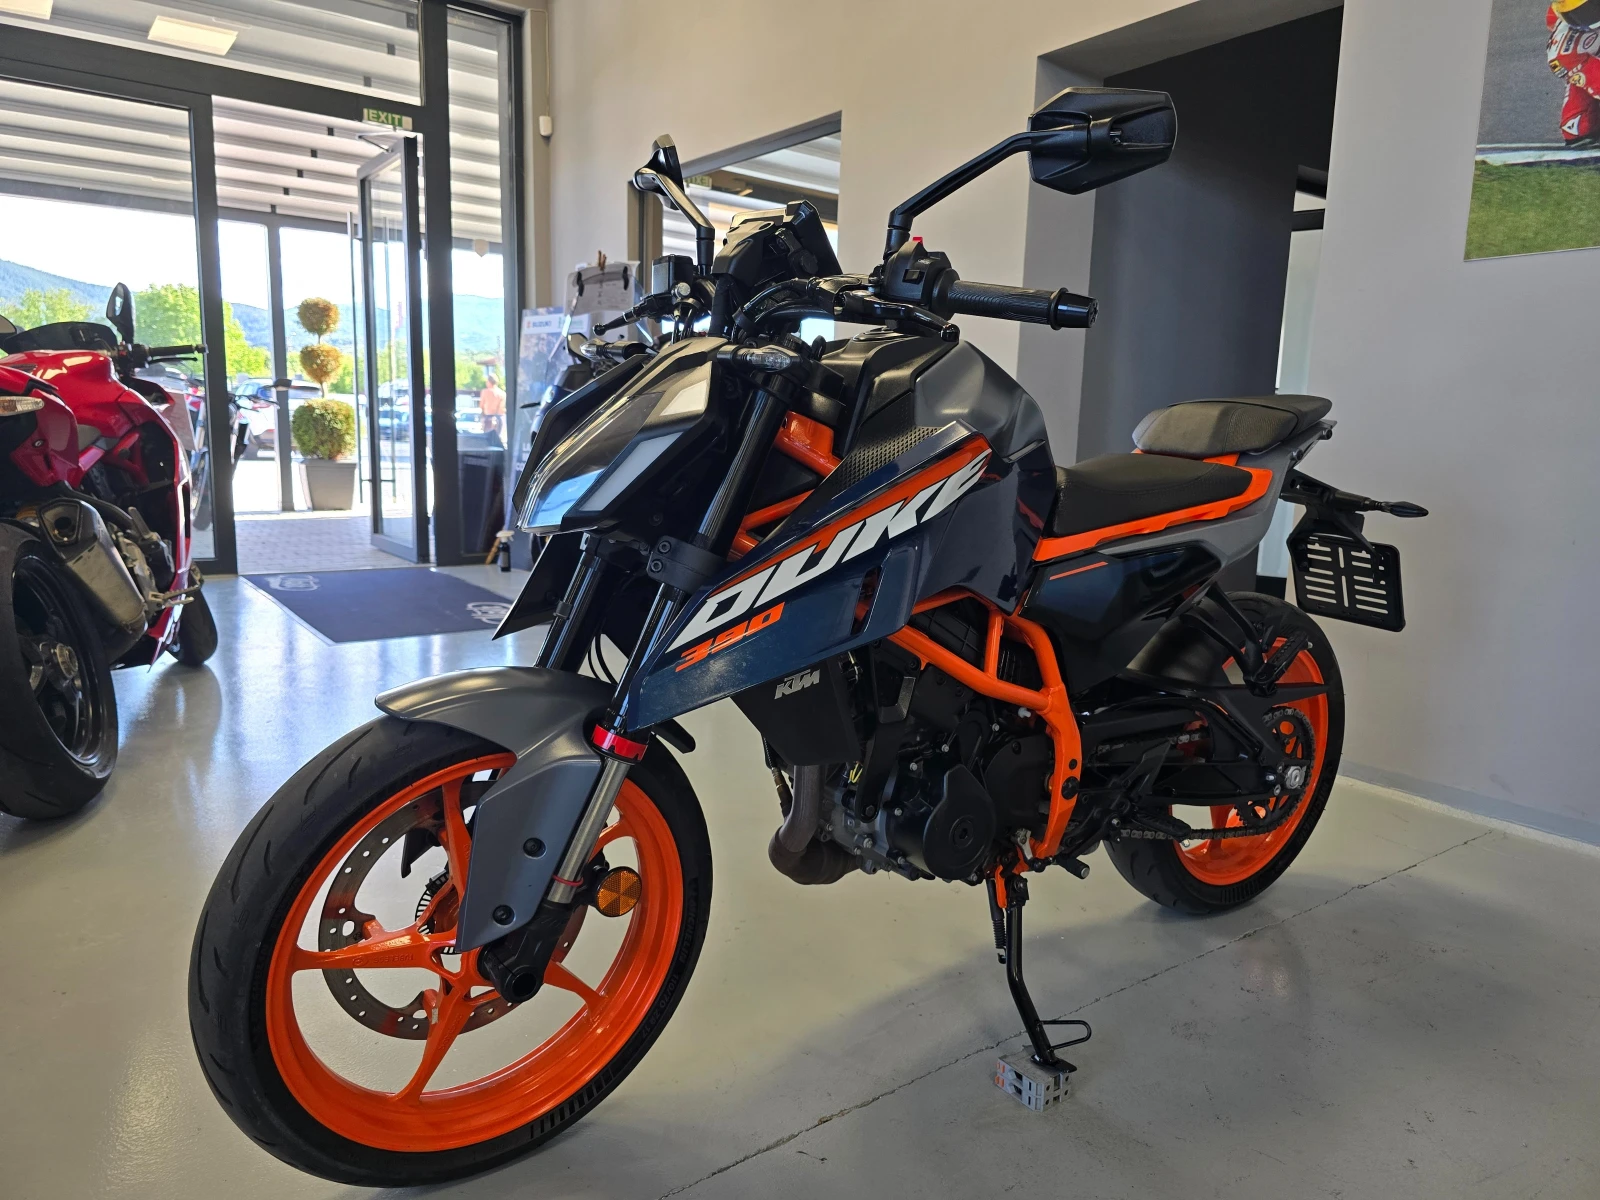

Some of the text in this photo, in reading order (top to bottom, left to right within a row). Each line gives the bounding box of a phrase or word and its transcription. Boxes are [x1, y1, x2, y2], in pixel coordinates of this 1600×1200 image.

[369, 109, 401, 127] EXIT
[665, 448, 992, 653] DUKE
[675, 601, 785, 672] 390
[774, 669, 820, 699] KTM
